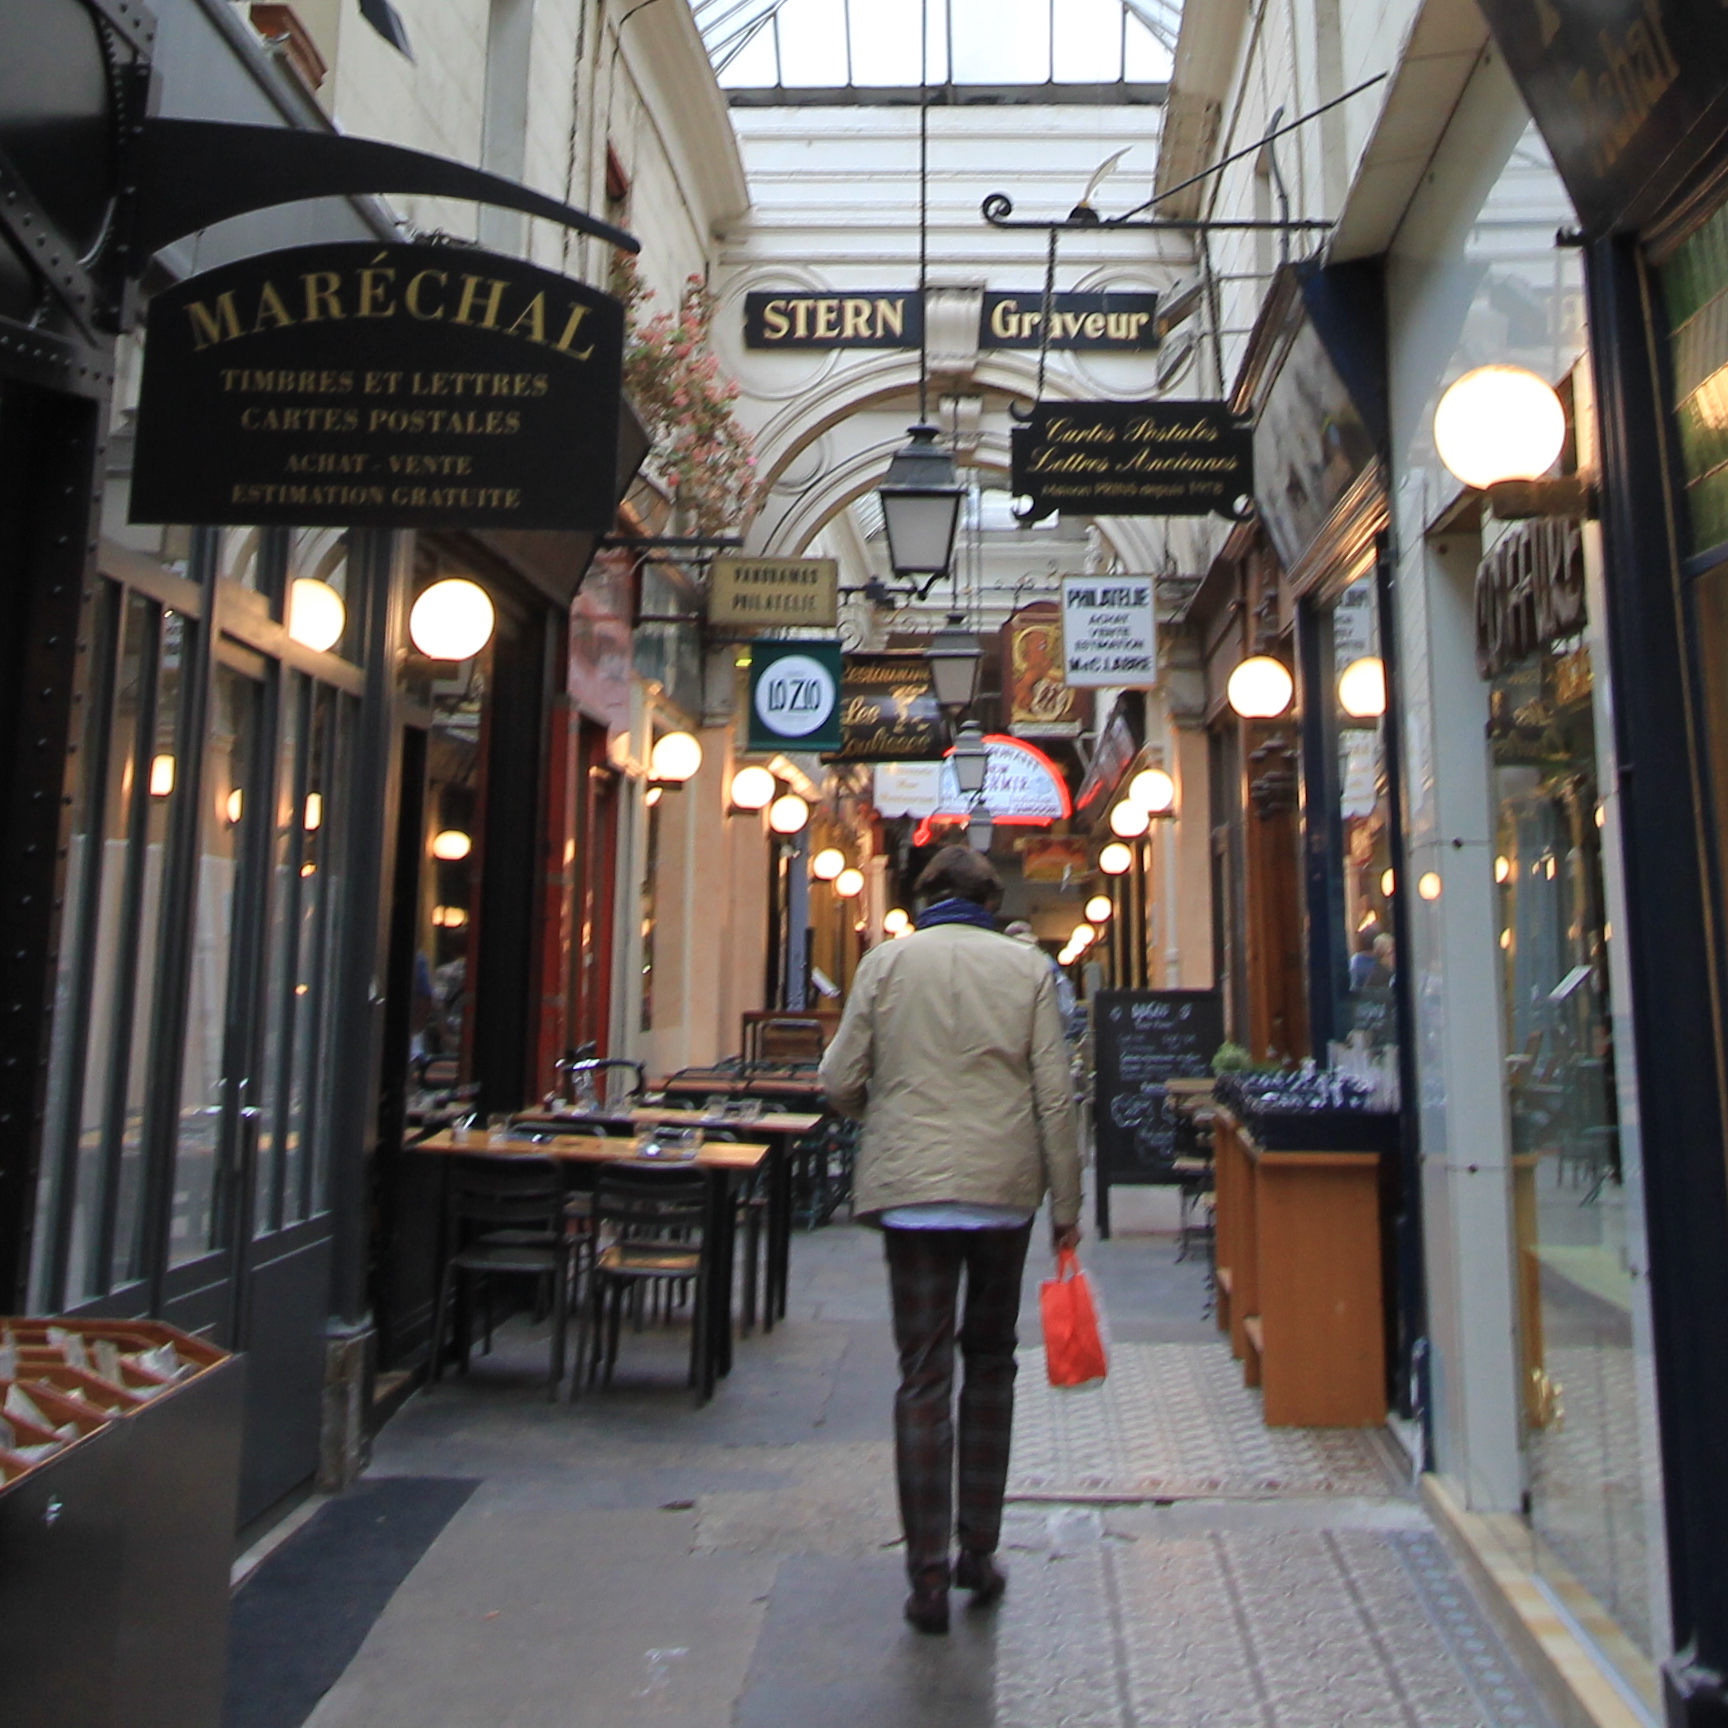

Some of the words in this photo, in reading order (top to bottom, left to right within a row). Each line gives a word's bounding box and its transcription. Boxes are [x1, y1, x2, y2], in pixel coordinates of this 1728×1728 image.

[183, 250, 595, 362] MARÉCHAL
[763, 298, 905, 340] STERN
[990, 299, 1150, 340] Graveur
[221, 368, 354, 393] TIMBRES
[364, 371, 402, 395] ET
[411, 372, 549, 397] LETTRES
[240, 407, 359, 432] CARTES
[368, 409, 521, 434] POSTALES
[1045, 417, 1117, 443] Cartes
[1122, 418, 1219, 442] Postales
[284, 453, 370, 473] ACHAT
[388, 455, 472, 476] VENTE
[1027, 446, 1110, 472] Lettres
[1115, 446, 1240, 471] Anciennes
[232, 484, 385, 505] ESTIMATION
[391, 487, 521, 509] GRATUITE
[1067, 585, 1150, 609] PHILATELIE
